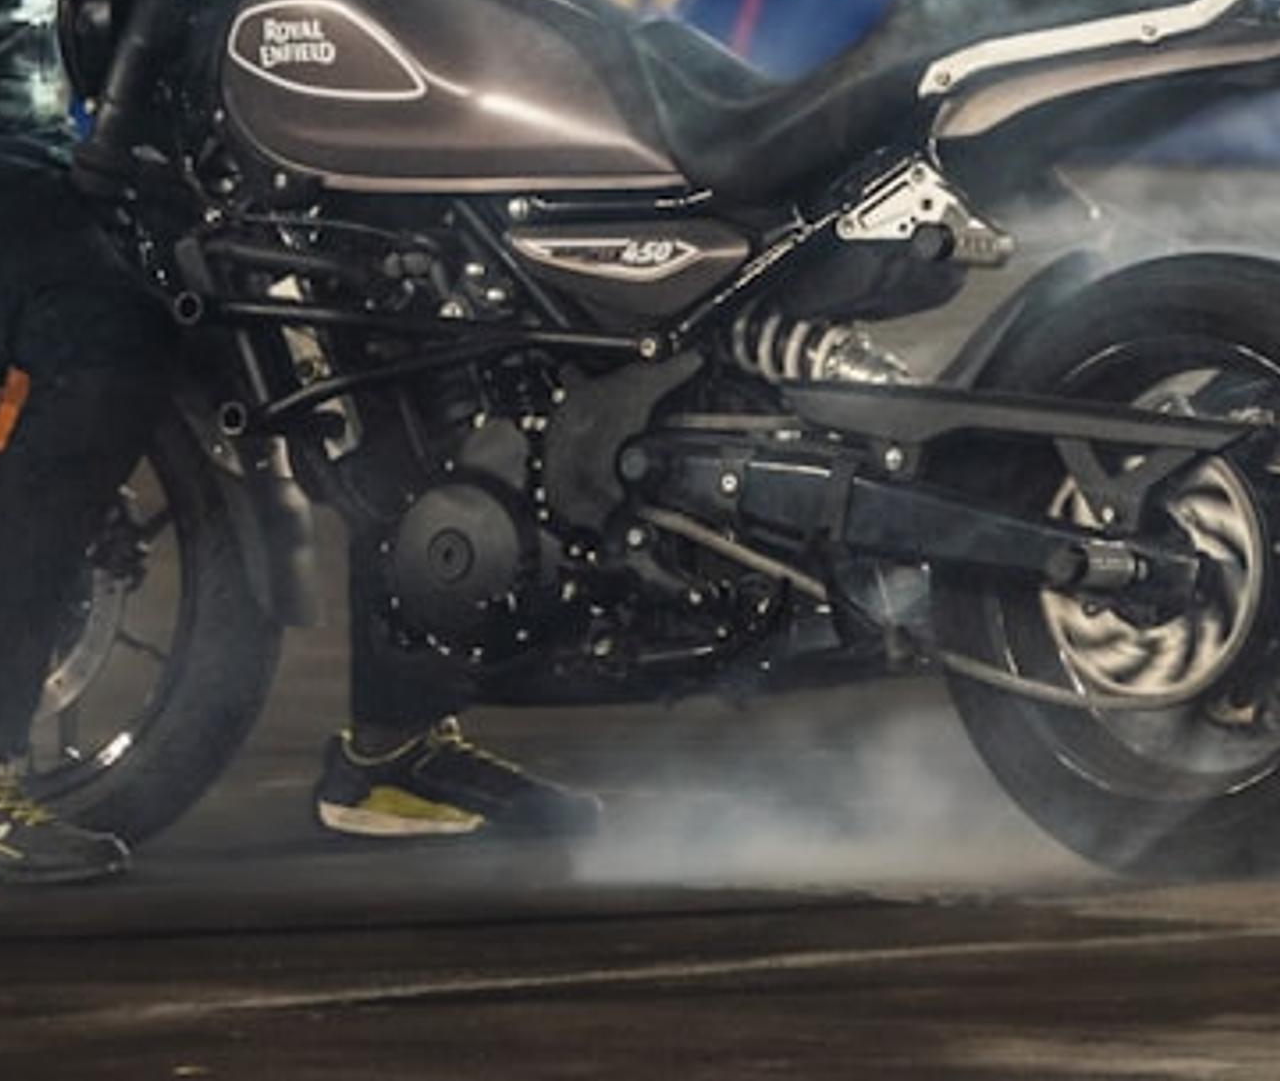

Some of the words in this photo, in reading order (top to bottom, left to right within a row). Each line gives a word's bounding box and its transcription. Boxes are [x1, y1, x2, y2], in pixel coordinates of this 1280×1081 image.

[261, 18, 325, 43] ROYAL
[258, 41, 337, 69] ENFIELD
[622, 240, 673, 264] 450
